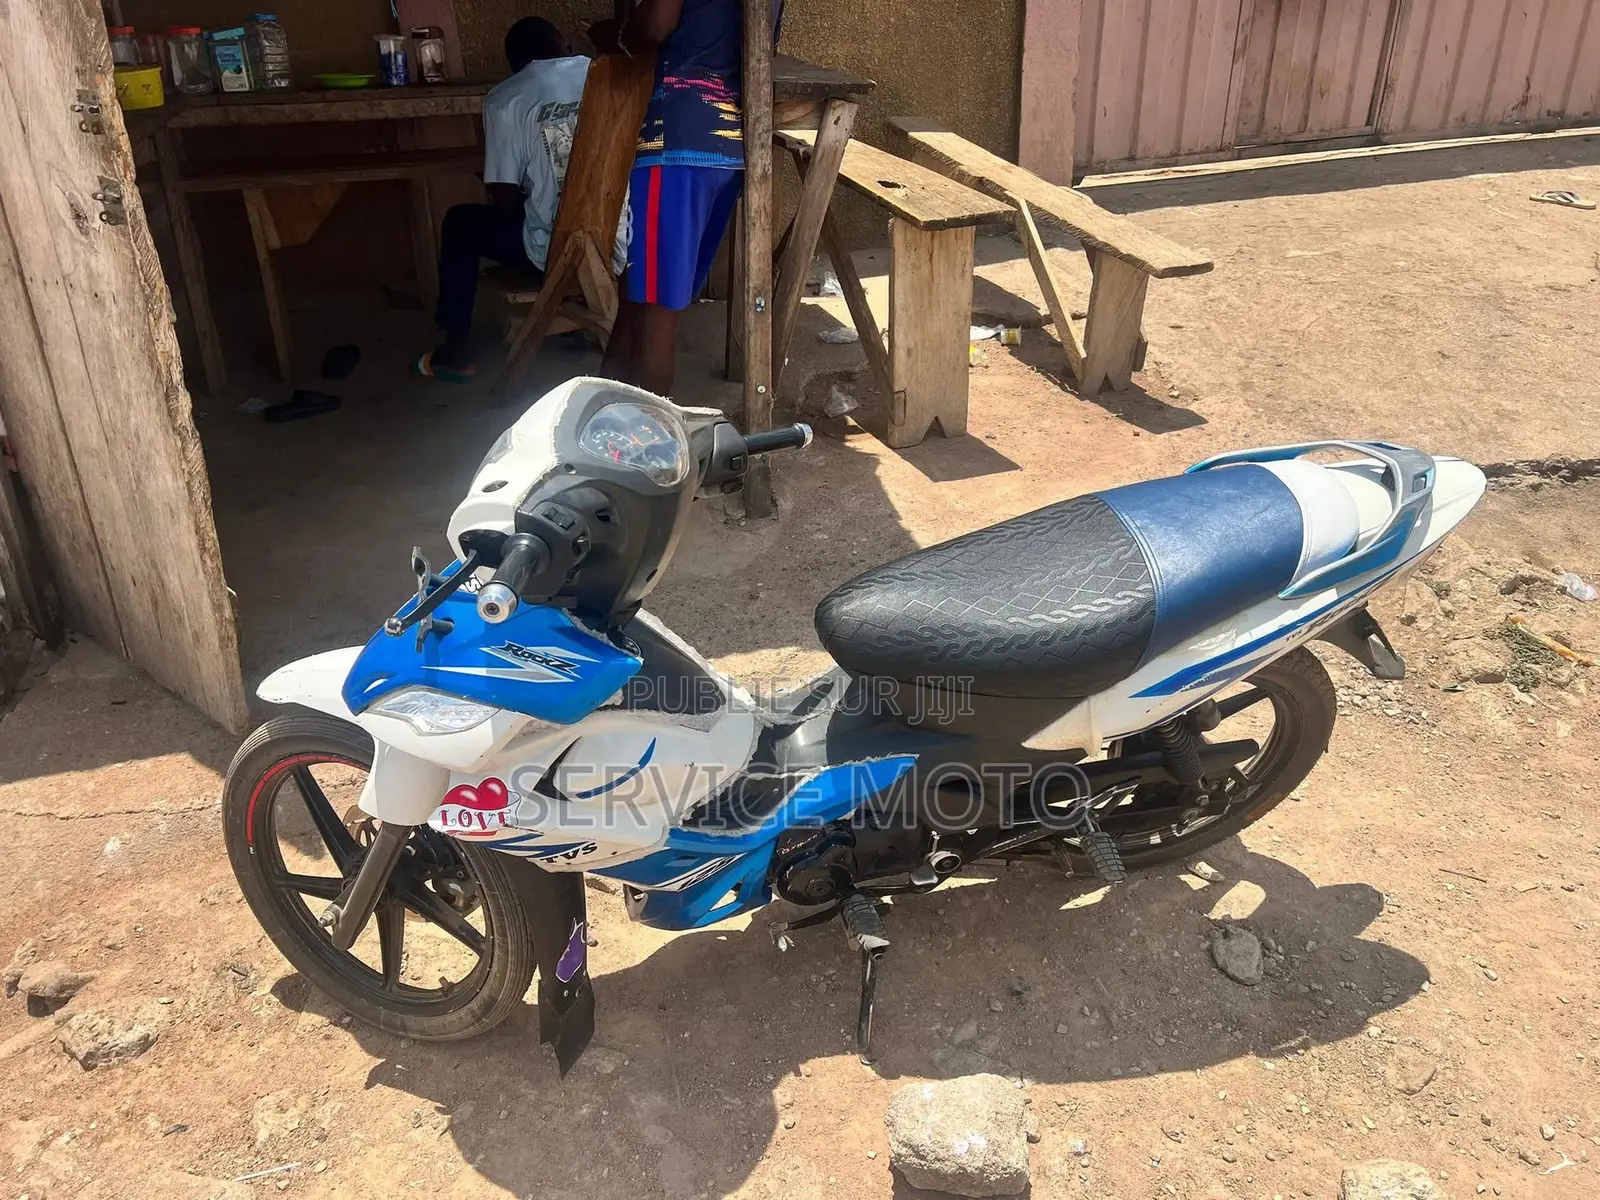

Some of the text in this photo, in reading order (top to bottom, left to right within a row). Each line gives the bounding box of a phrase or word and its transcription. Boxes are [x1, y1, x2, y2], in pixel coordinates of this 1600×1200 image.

[499, 641, 580, 675] ROCKZ
[440, 808, 511, 830] LOVE
[539, 842, 598, 863] TVS
